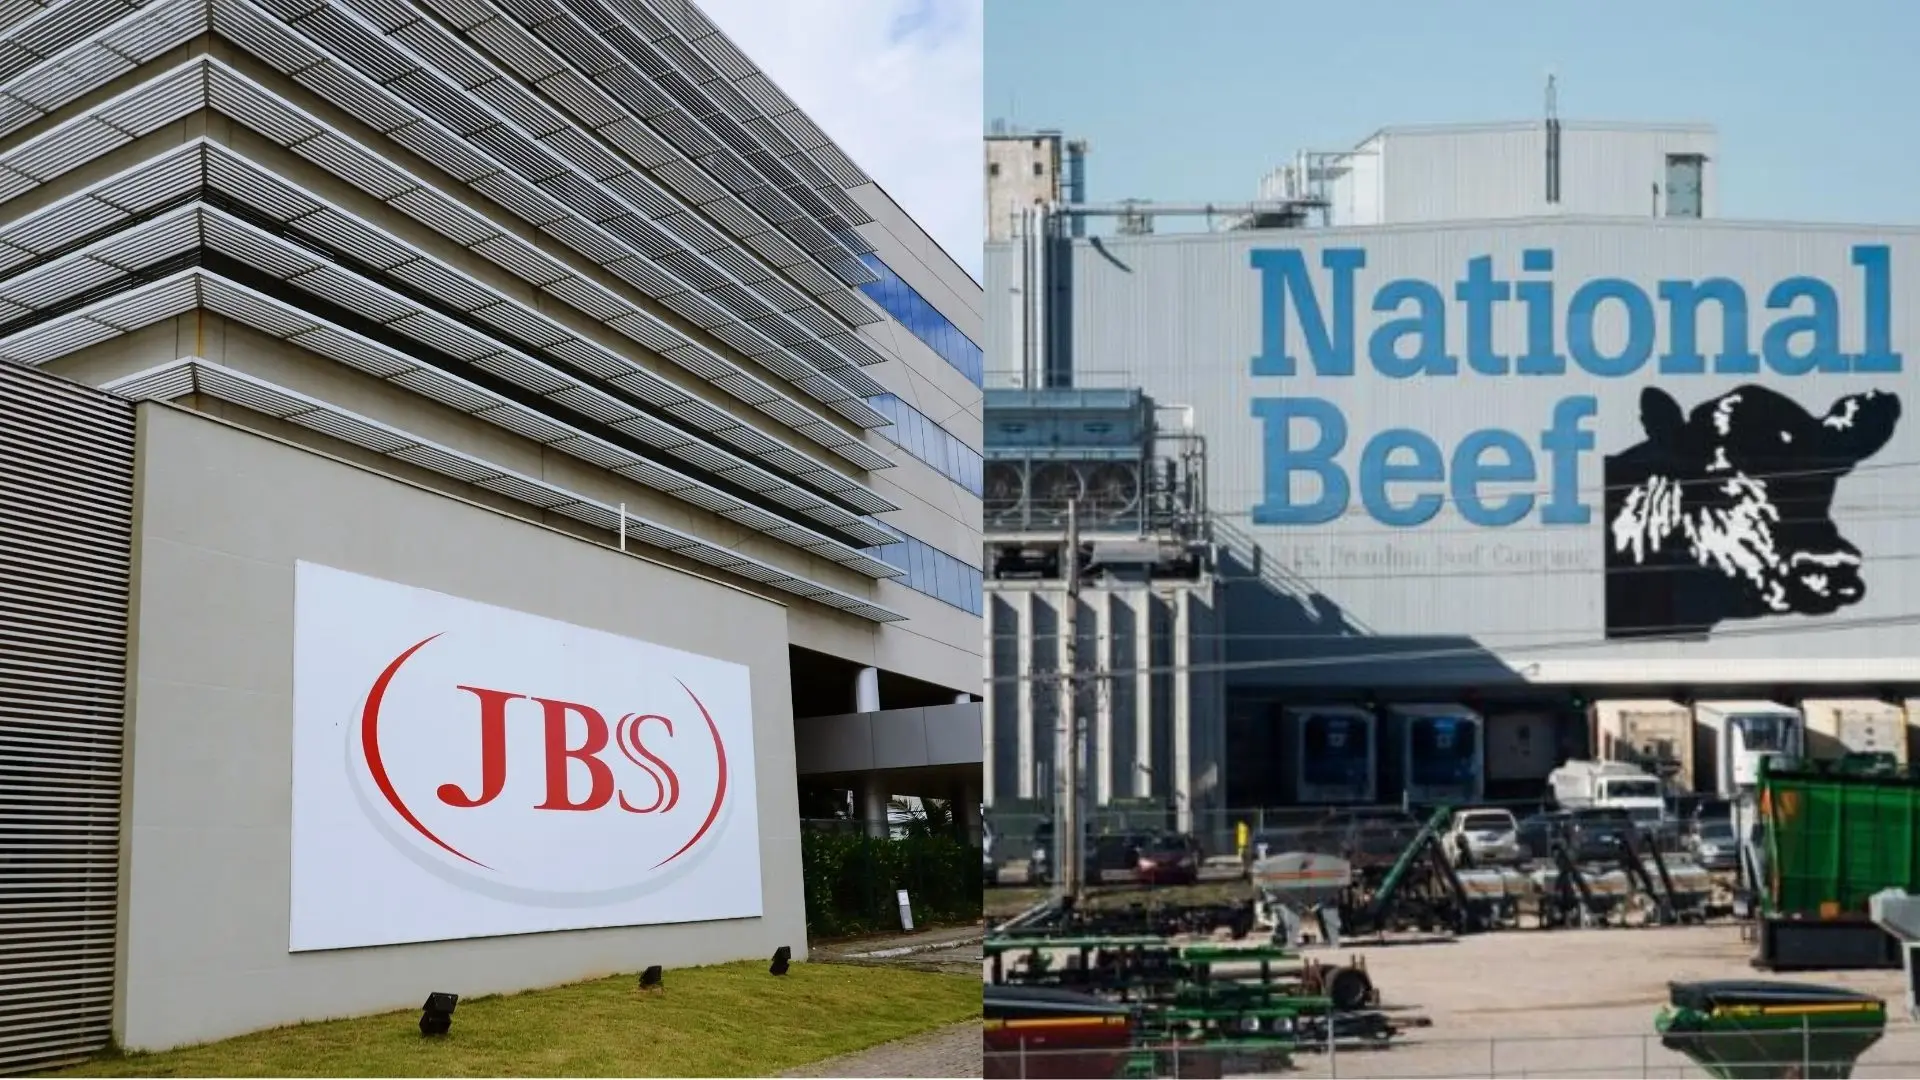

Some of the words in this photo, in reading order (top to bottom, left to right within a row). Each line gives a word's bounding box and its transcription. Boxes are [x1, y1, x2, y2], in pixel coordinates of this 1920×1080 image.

[1249, 245, 1903, 378] National
[1250, 396, 1598, 527] Beef
[437, 685, 679, 813] JBS
